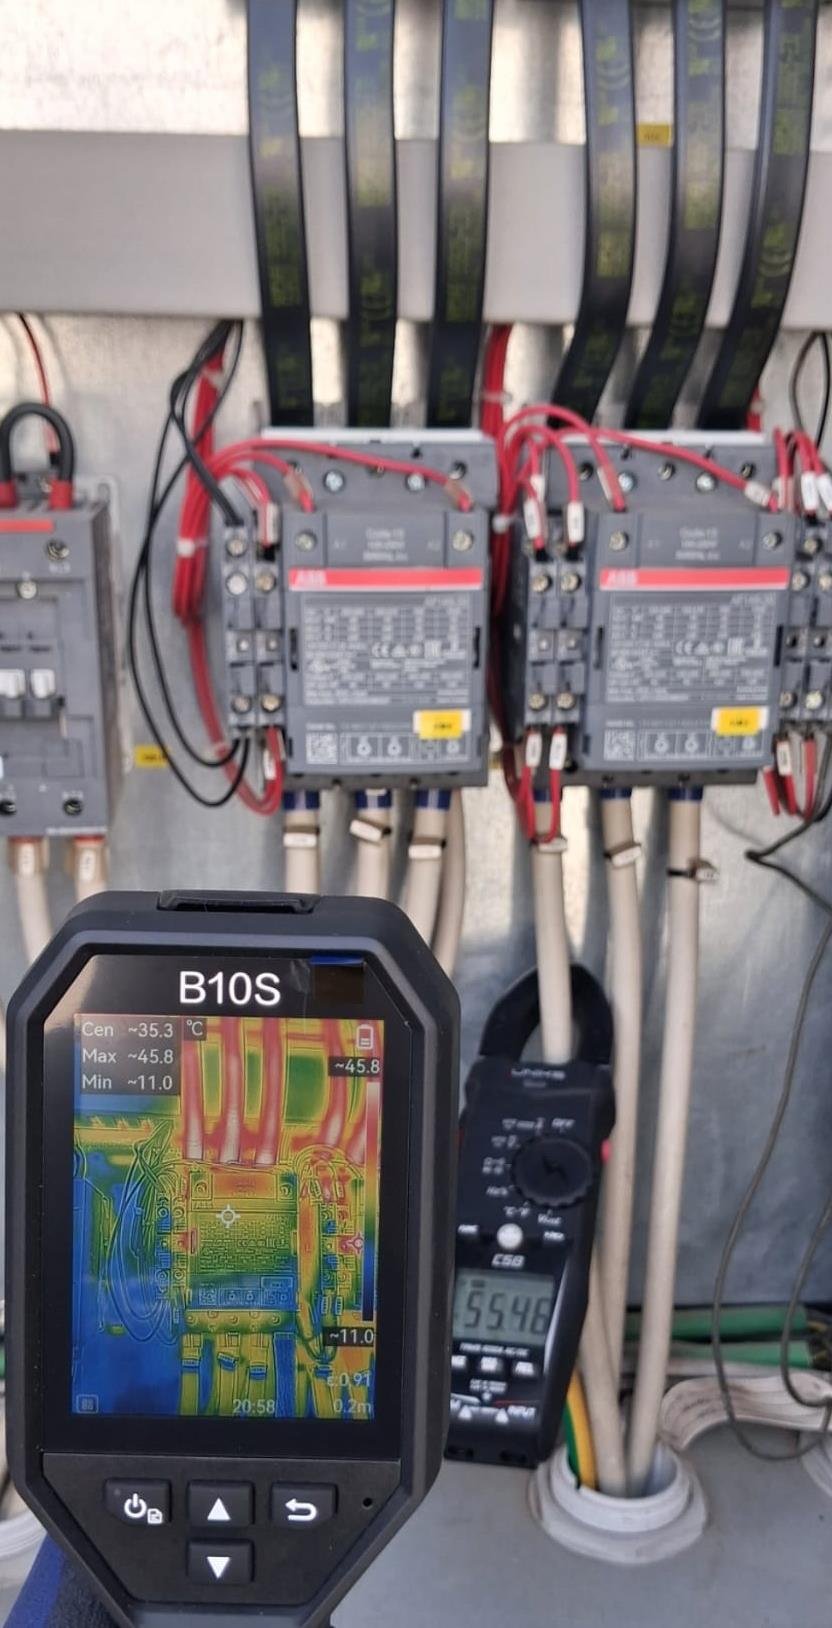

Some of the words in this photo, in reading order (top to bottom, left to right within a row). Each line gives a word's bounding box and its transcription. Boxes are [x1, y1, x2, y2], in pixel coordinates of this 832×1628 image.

[295, 571, 327, 586] ABB
[606, 570, 638, 585] ABB
[179, 970, 281, 1007] B10S
[82, 1022, 114, 1037] Cen
[128, 1022, 174, 1038] ~35.3
[82, 1048, 117, 1063] Max
[128, 1049, 174, 1064] ~45.8
[335, 1058, 380, 1074] ~45.8
[82, 1074, 112, 1089] Min
[128, 1075, 173, 1090] ~11.0
[329, 1329, 374, 1343] ~11.0
[232, 1398, 276, 1414] 20:58
[333, 1398, 372, 1413] 0.2m
